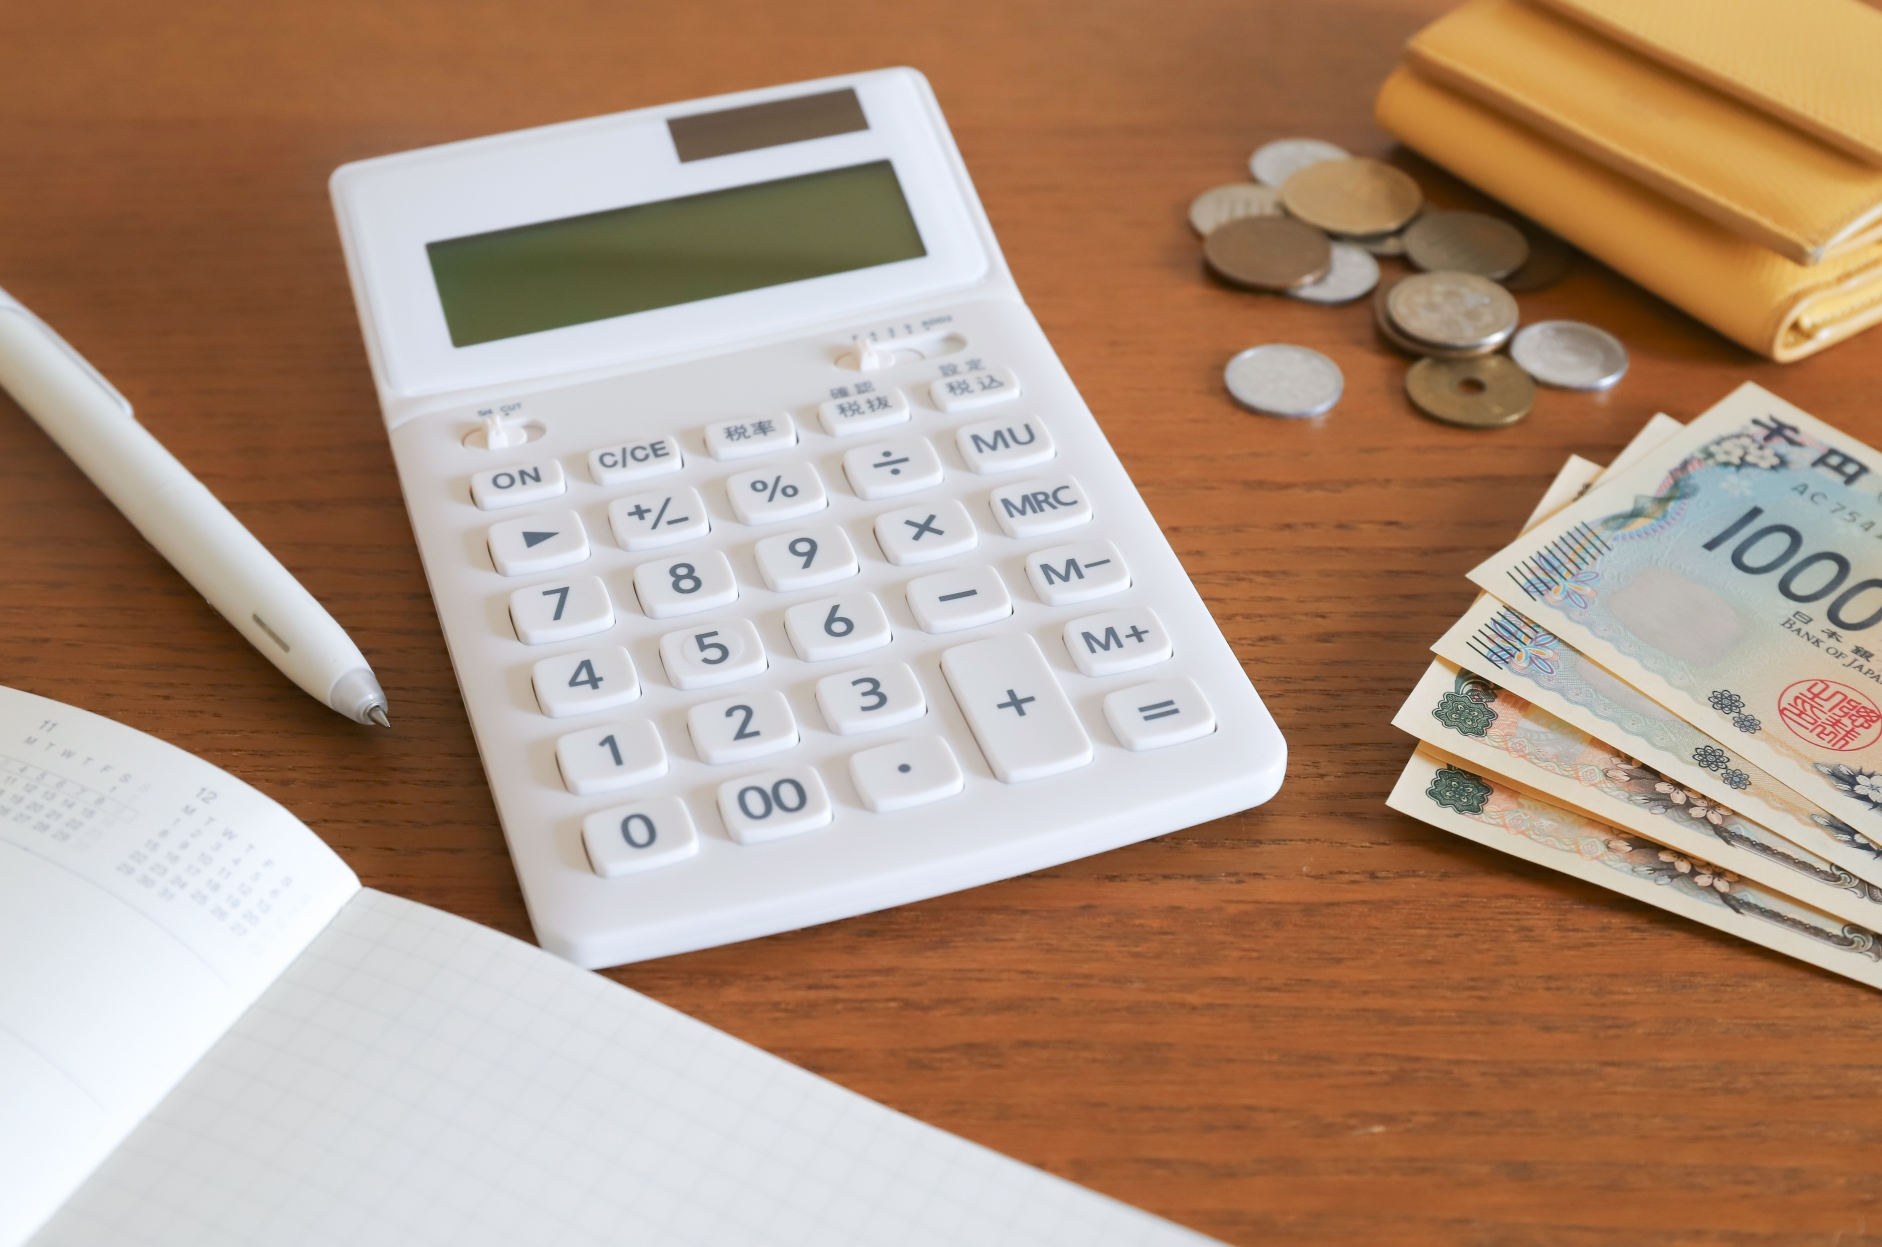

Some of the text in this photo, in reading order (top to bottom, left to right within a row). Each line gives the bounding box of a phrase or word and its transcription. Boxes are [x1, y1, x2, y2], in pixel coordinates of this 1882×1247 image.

[945, 374, 1004, 397] 税込
[836, 395, 893, 418] 税抜
[724, 418, 778, 442] 税率
[970, 423, 1036, 454] MU
[598, 440, 671, 469] C/CE
[491, 466, 543, 490] ON
[750, 475, 800, 503] %
[1000, 485, 1078, 518] MRC
[788, 537, 819, 570] 9
[1702, 505, 1882, 632] 1000
[669, 562, 703, 595] 8
[542, 586, 570, 621] 7
[824, 604, 855, 637] 6
[695, 630, 730, 665] 5
[1081, 624, 1150, 655] M+
[1780, 617, 1825, 649] BANK
[1826, 646, 1848, 660] OF
[568, 659, 604, 690] 4
[851, 677, 888, 711] 3
[725, 704, 761, 741] 2
[598, 734, 624, 766] 1
[736, 778, 808, 820] 00
[620, 813, 658, 849] 0
